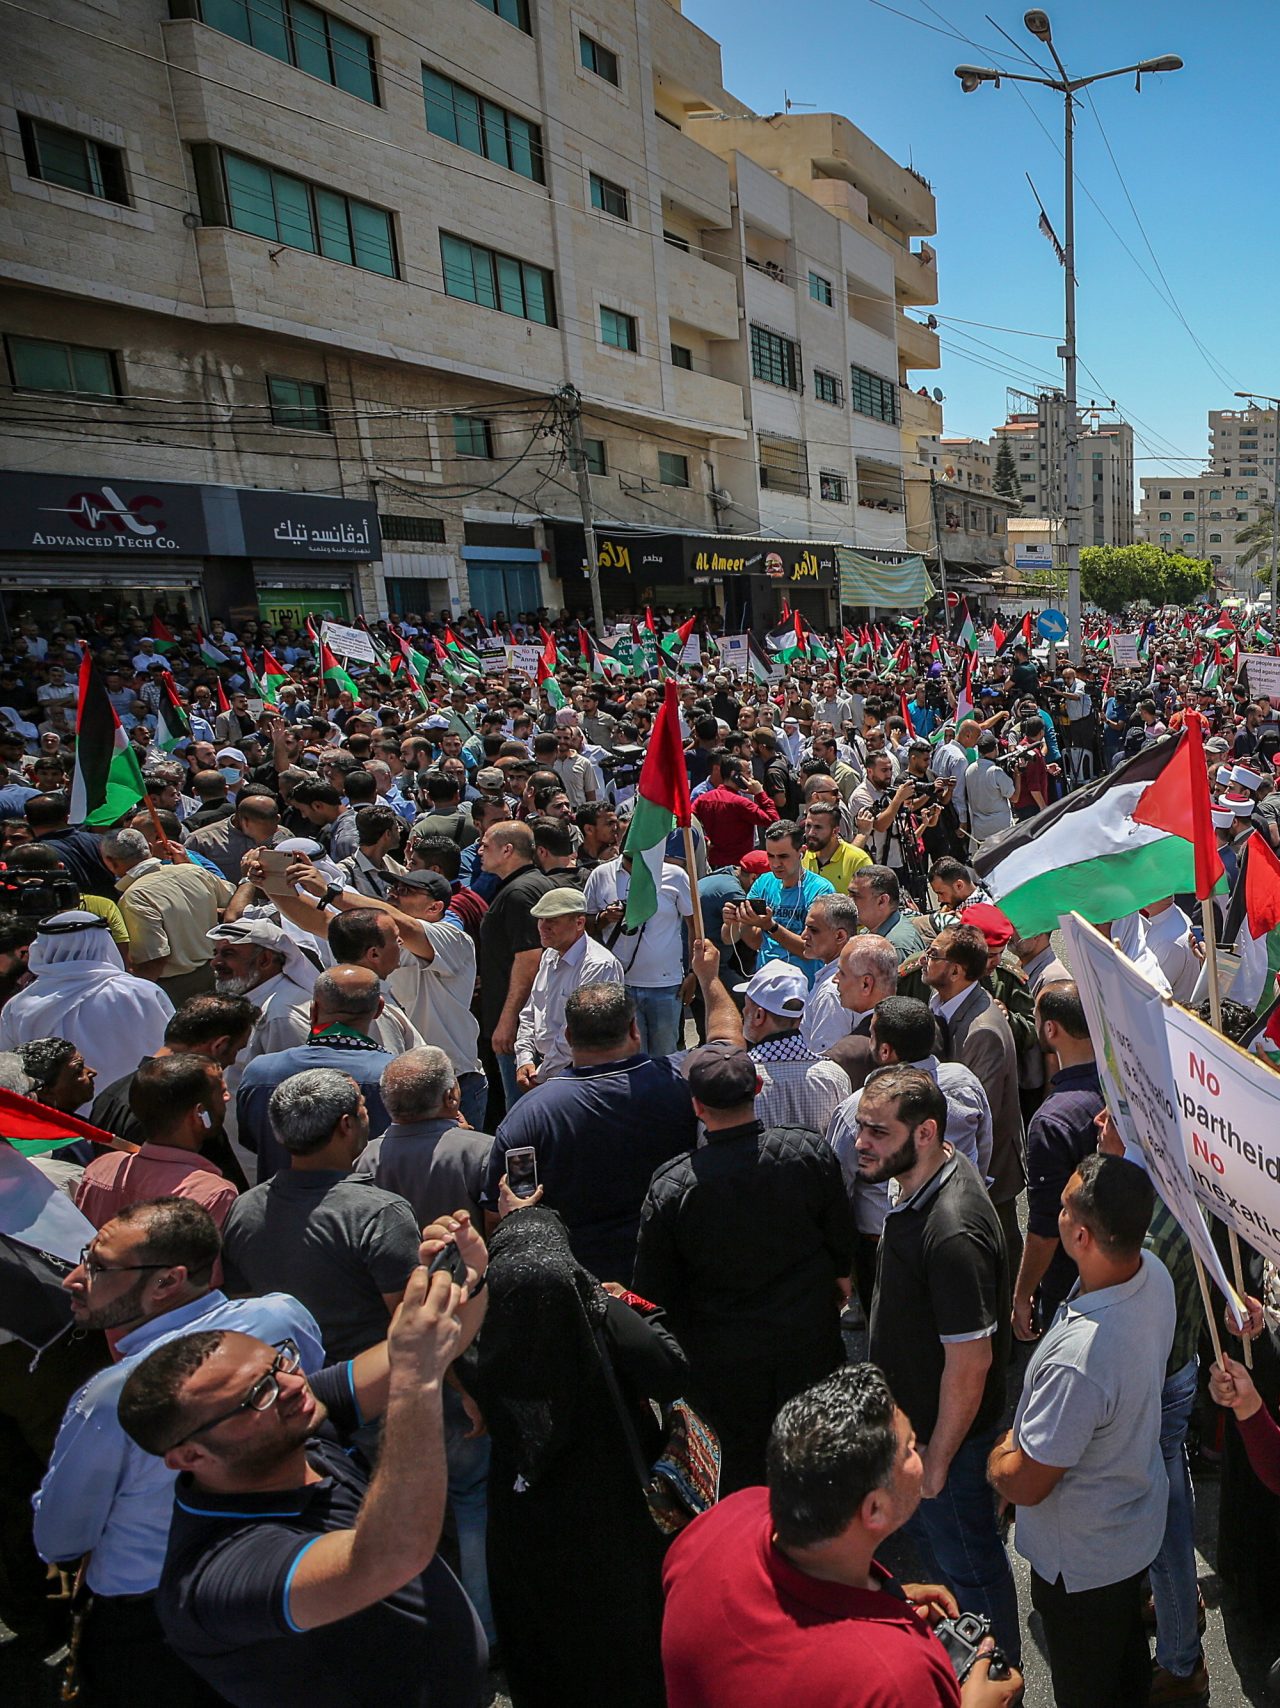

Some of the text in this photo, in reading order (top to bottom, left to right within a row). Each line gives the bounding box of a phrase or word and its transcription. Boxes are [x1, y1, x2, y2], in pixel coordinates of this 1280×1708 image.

[791, 550, 819, 581] الأمير
[1258, 660, 1272, 668] people
[1189, 1052, 1221, 1097] No
[1192, 1132, 1225, 1175] No
